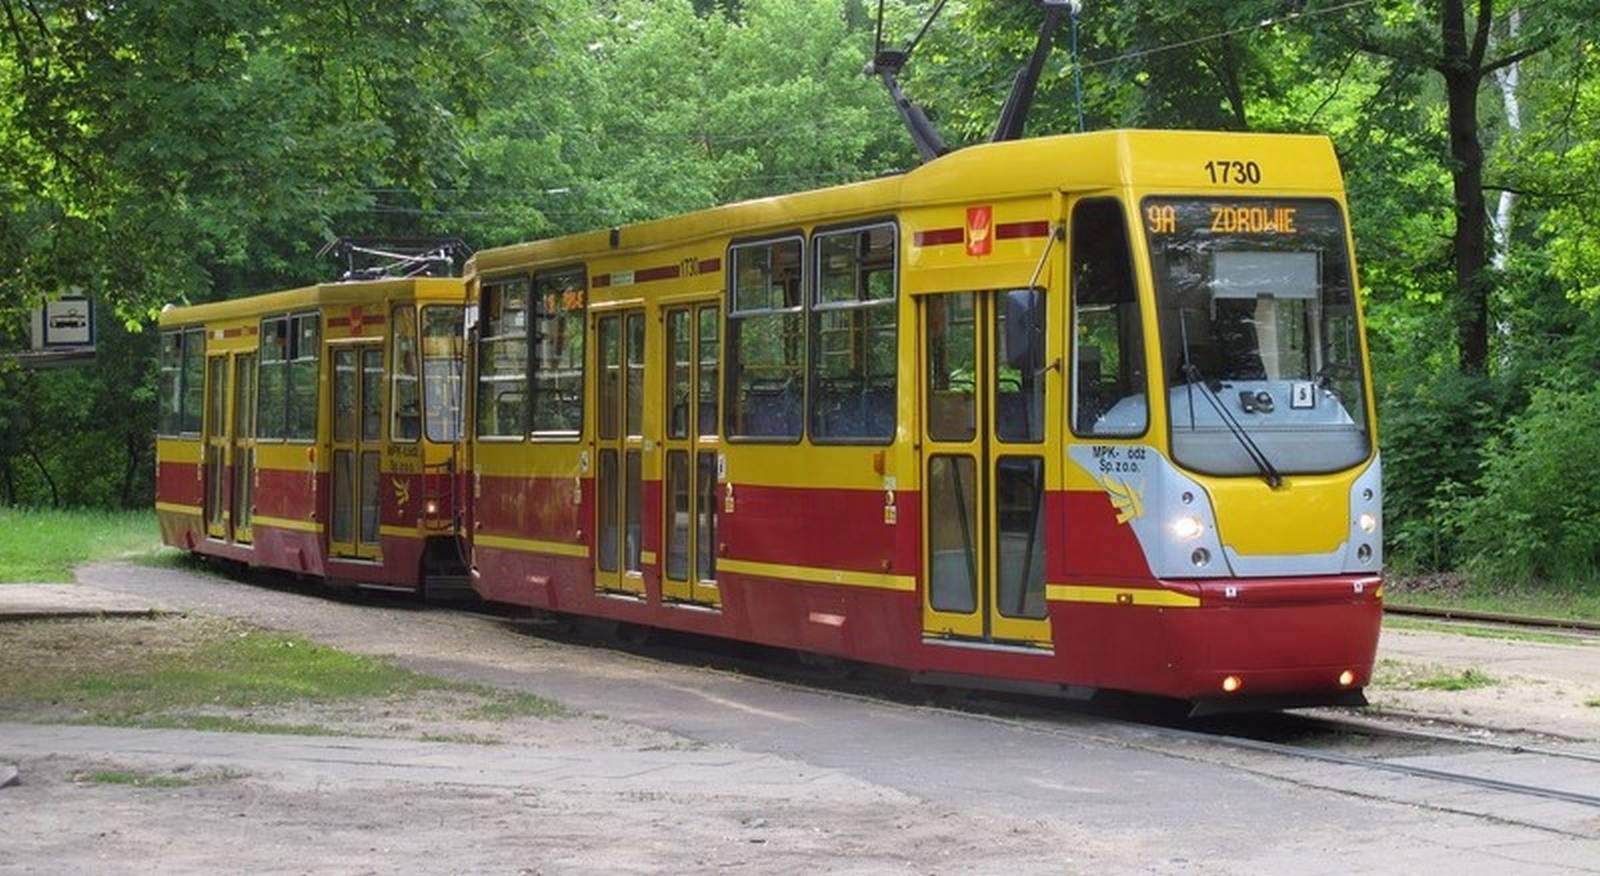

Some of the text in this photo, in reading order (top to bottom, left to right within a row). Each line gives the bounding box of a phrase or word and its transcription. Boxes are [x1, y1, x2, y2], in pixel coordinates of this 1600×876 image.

[1204, 161, 1261, 184] 1730
[1148, 206, 1296, 233] 9A ZDROWIE
